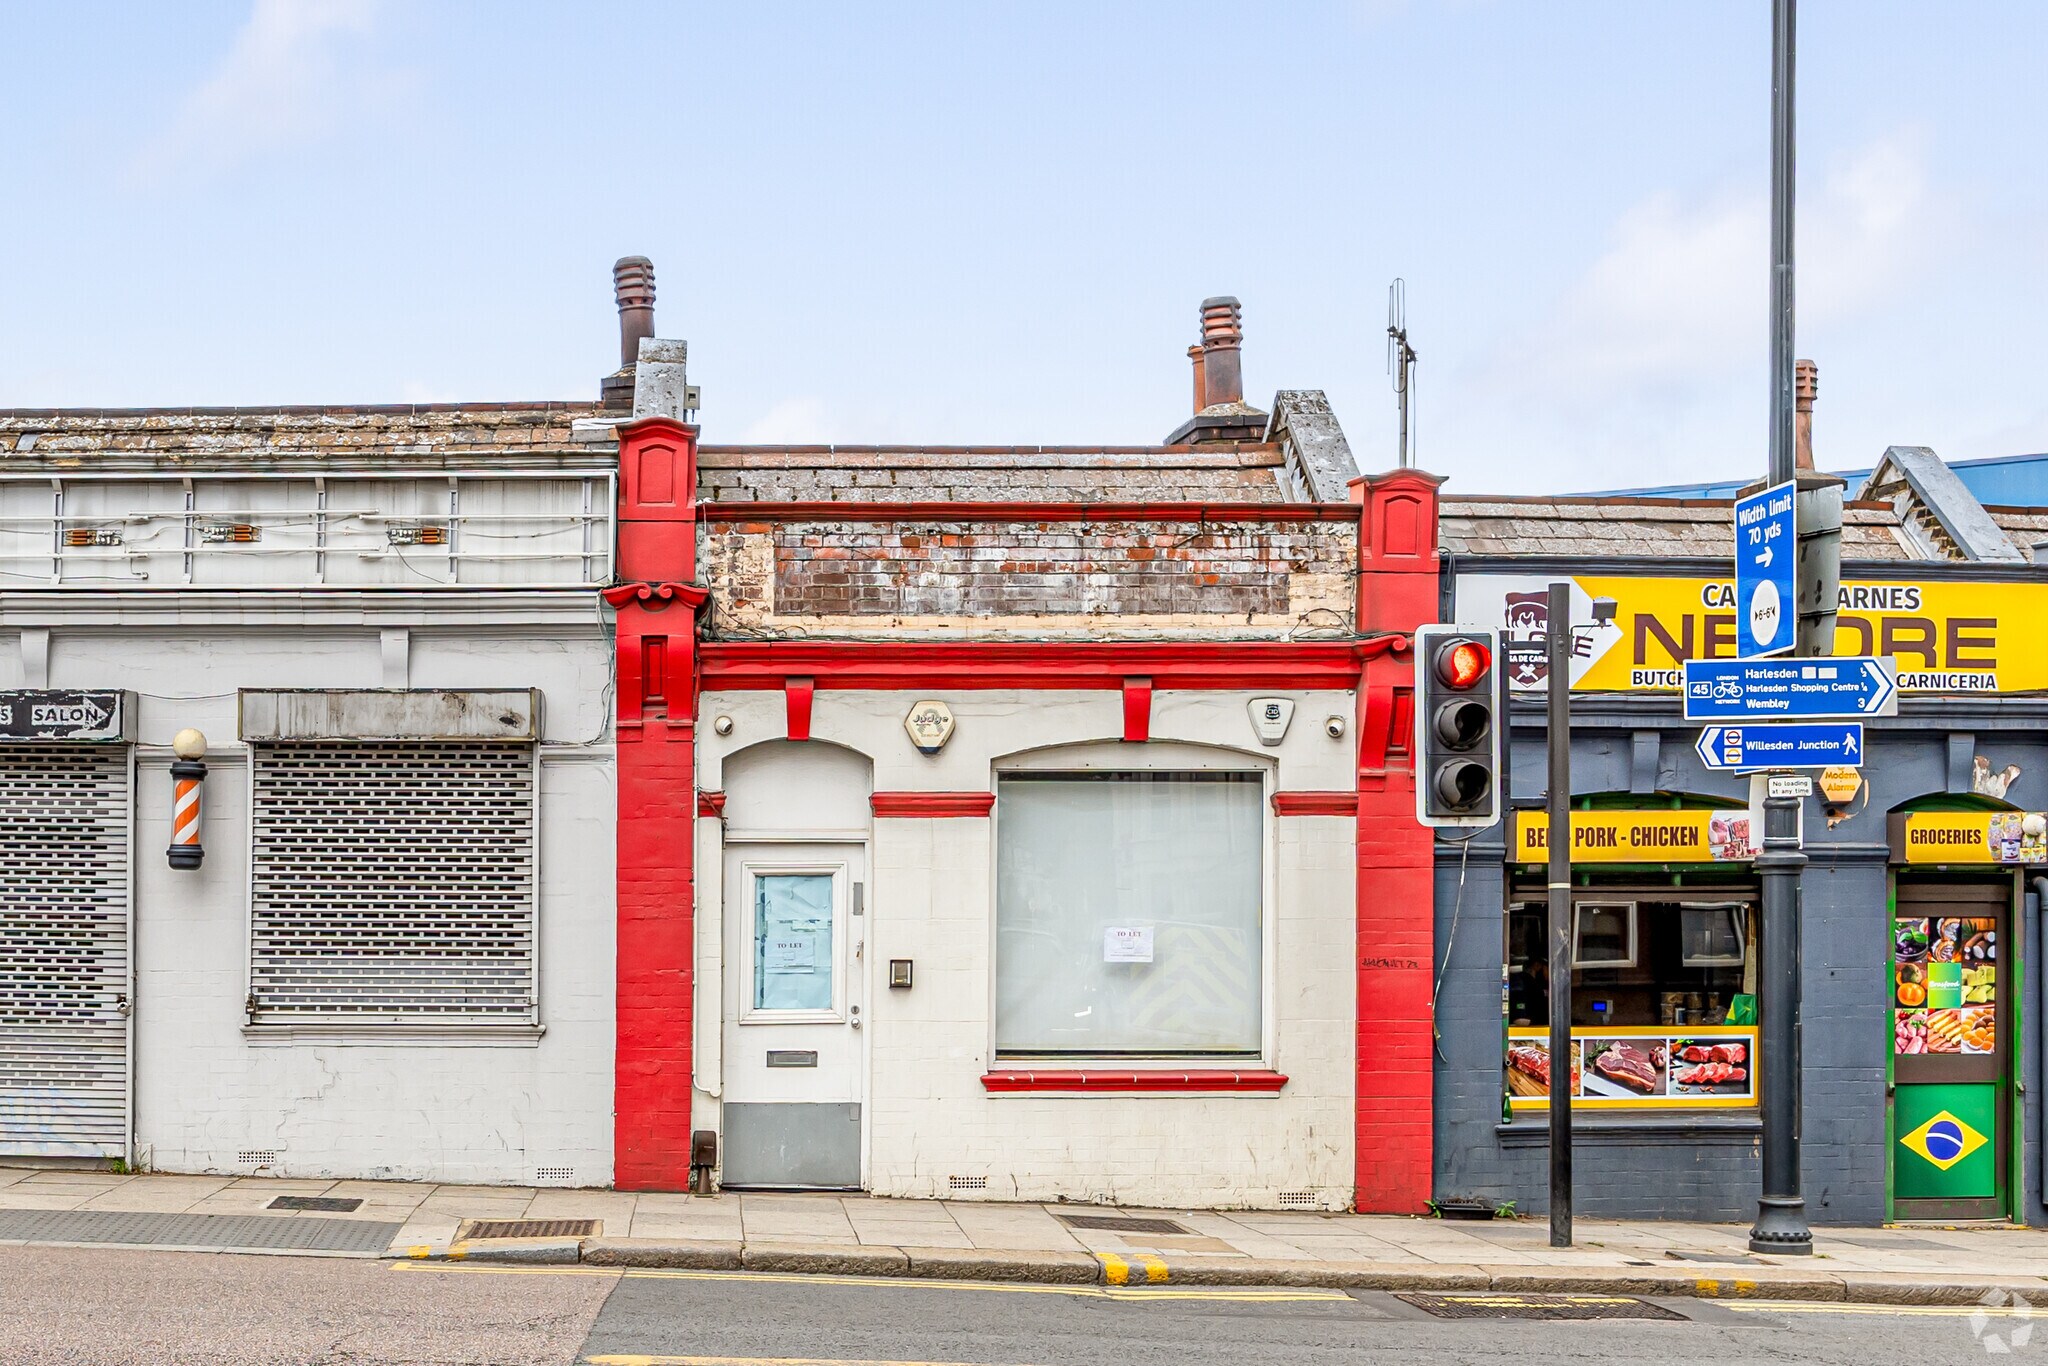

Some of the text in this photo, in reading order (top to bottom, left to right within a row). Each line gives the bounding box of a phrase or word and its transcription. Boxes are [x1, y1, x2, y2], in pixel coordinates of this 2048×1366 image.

[1739, 494, 1791, 527] Width limit
[1748, 521, 1782, 546] 70 yds
[1702, 585, 1920, 610] CA ARNES
[1633, 613, 1998, 669] NEORE
[1745, 668, 1798, 679] Harlesden
[1896, 673, 1996, 689] CARNICERIA
[1692, 684, 1709, 695] 45
[1746, 683, 1789, 693] Harlesden
[1791, 683, 1829, 694] Shopping
[1831, 683, 1860, 692] Centre
[1746, 697, 1866, 710] Wembley 3
[34, 708, 98, 721] SALON
[913, 714, 949, 725] Judge
[1746, 740, 1840, 751] Willesden Junction
[1825, 771, 1858, 780] Modern
[1826, 783, 1856, 791] Alarms
[1526, 827, 1550, 848] BE
[1575, 827, 1618, 848] PORK
[1630, 826, 1699, 847] CHICKEN
[1910, 829, 1982, 845] GROCERIES
